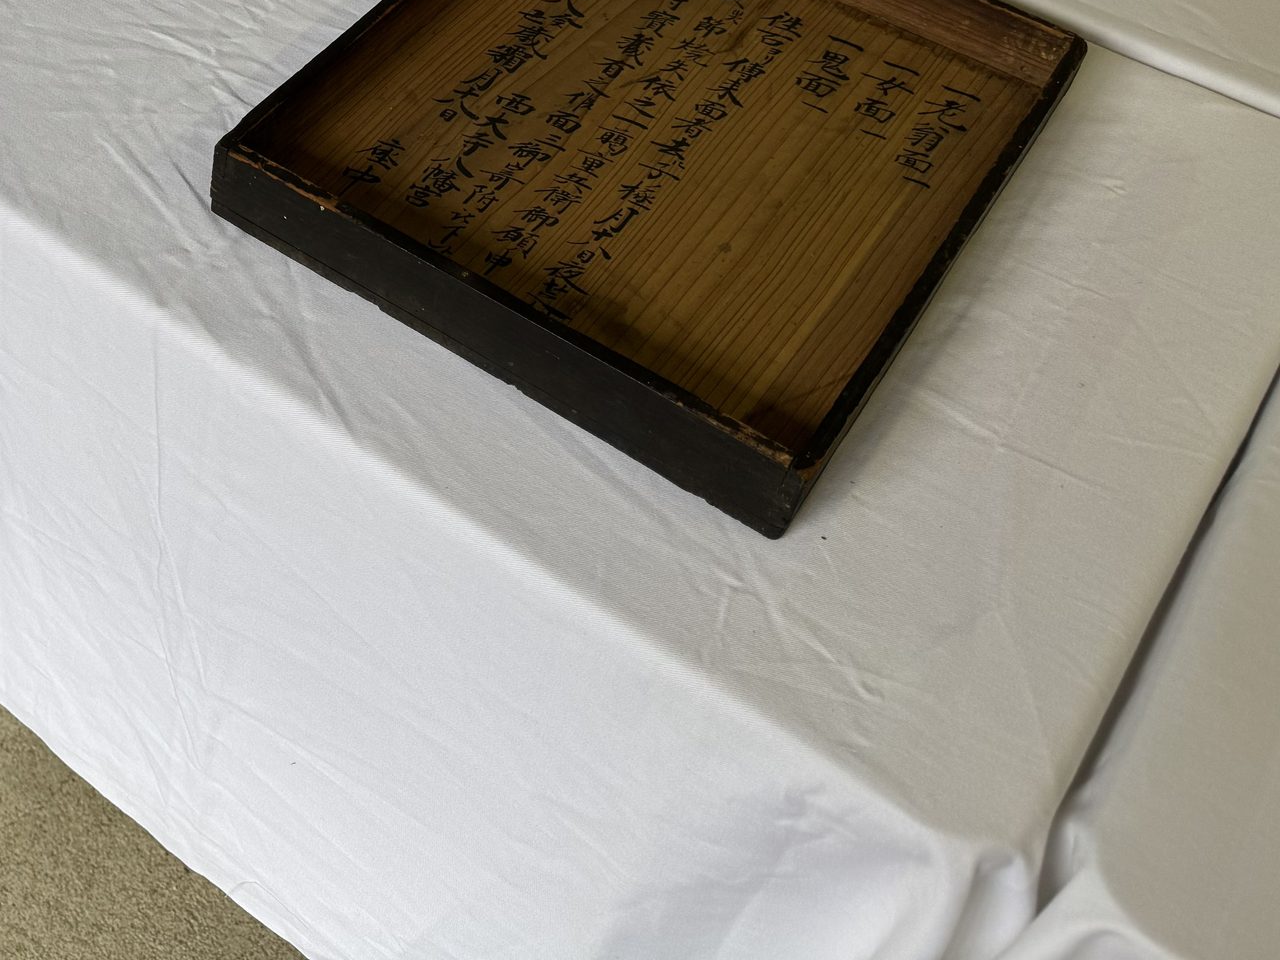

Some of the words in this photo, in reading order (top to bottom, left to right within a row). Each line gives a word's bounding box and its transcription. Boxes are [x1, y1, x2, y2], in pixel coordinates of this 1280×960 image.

[403, 91, 537, 208] 西大寺八幡宮
